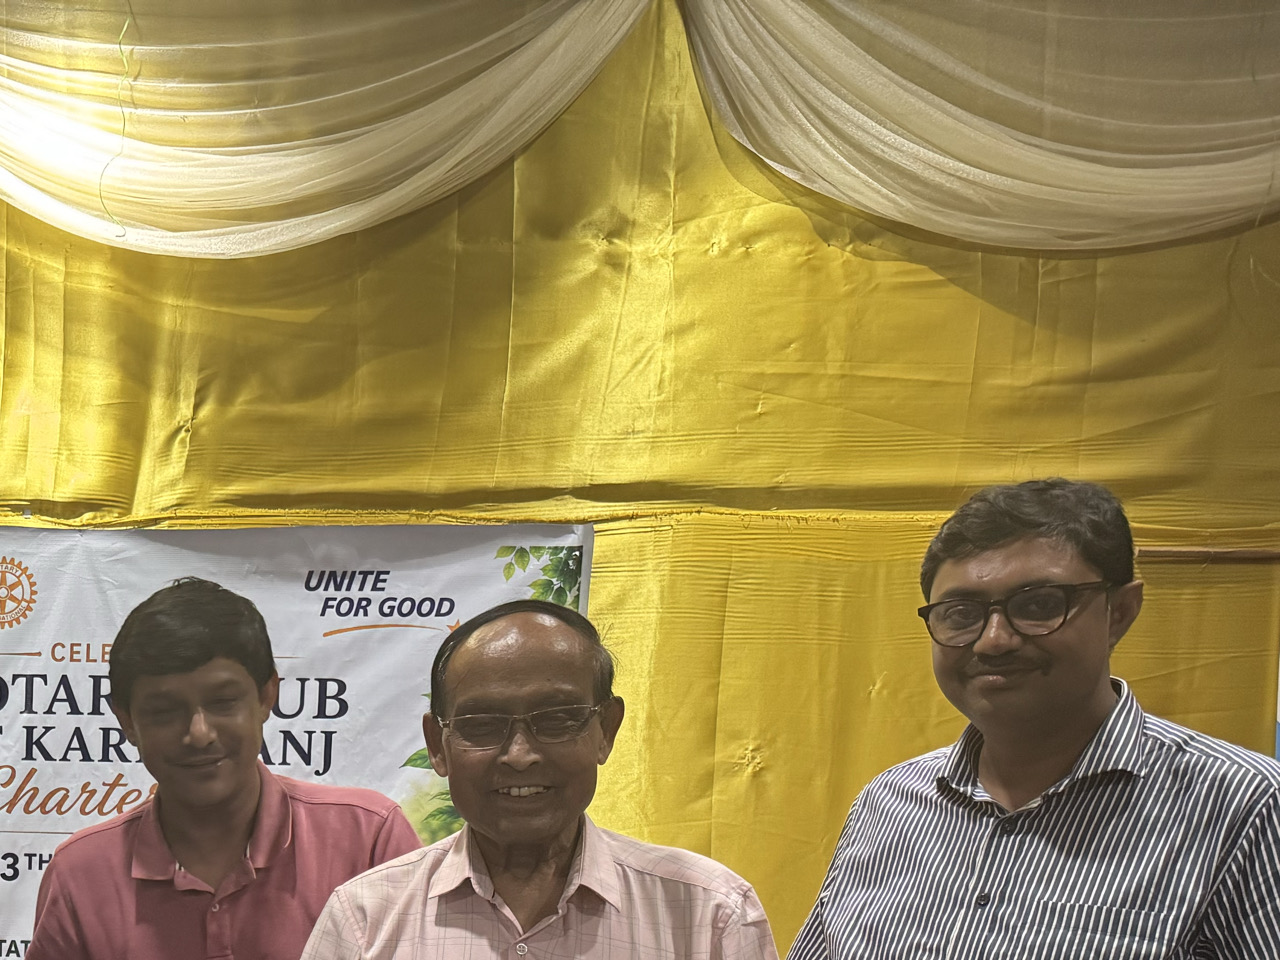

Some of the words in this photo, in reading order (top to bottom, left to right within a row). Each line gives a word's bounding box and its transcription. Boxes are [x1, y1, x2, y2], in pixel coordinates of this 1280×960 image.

[304, 570, 390, 592] UNITE
[320, 597, 372, 618] FOR
[378, 597, 455, 618] GOOD
